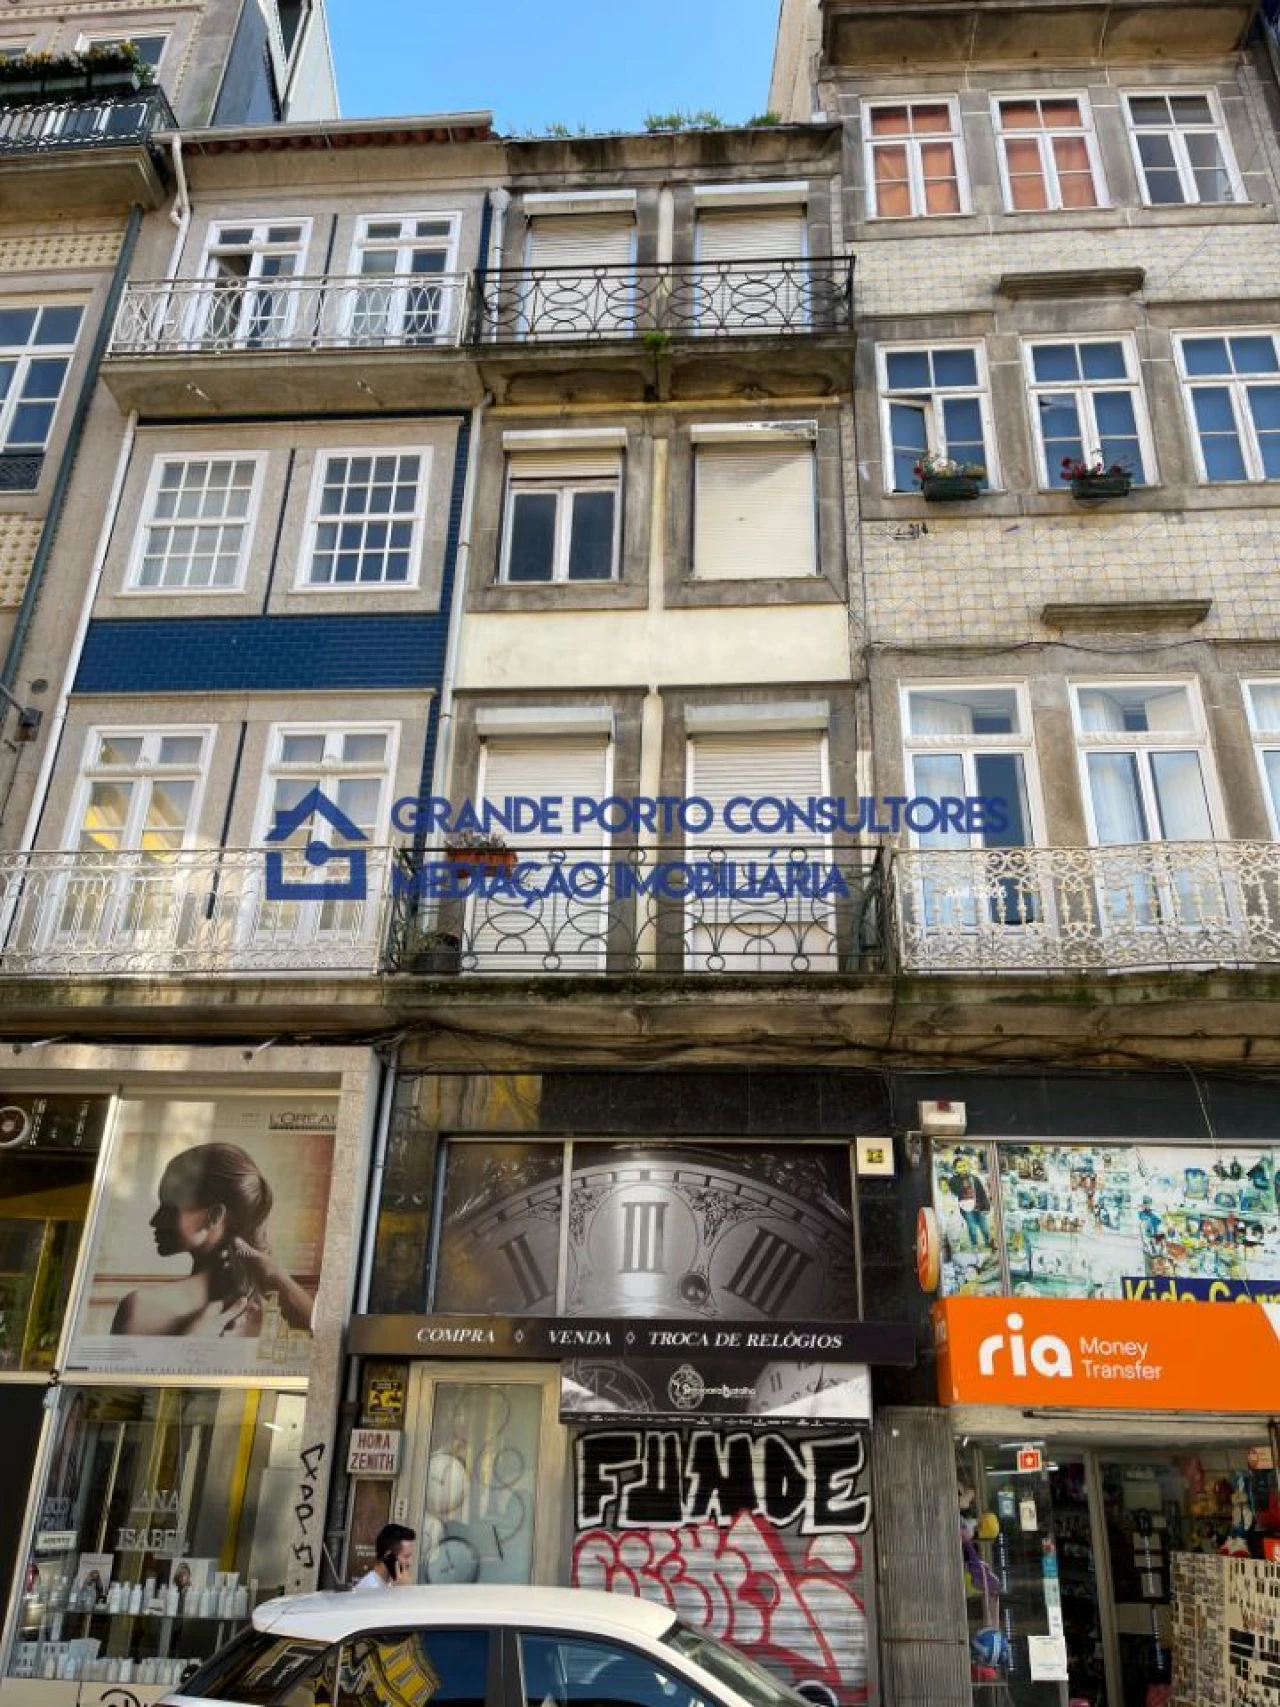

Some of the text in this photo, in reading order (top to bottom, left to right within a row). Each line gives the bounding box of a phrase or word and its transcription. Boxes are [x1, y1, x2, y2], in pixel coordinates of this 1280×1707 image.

[417, 1327, 843, 1349] COMPRA VENDA TROCA DE RELÓGIOS
[979, 1312, 1073, 1378] ria
[1080, 1336, 1148, 1360] Money
[1081, 1359, 1163, 1379] Transfer
[357, 1432, 391, 1450] HORA
[350, 1452, 395, 1471] ZENITH
